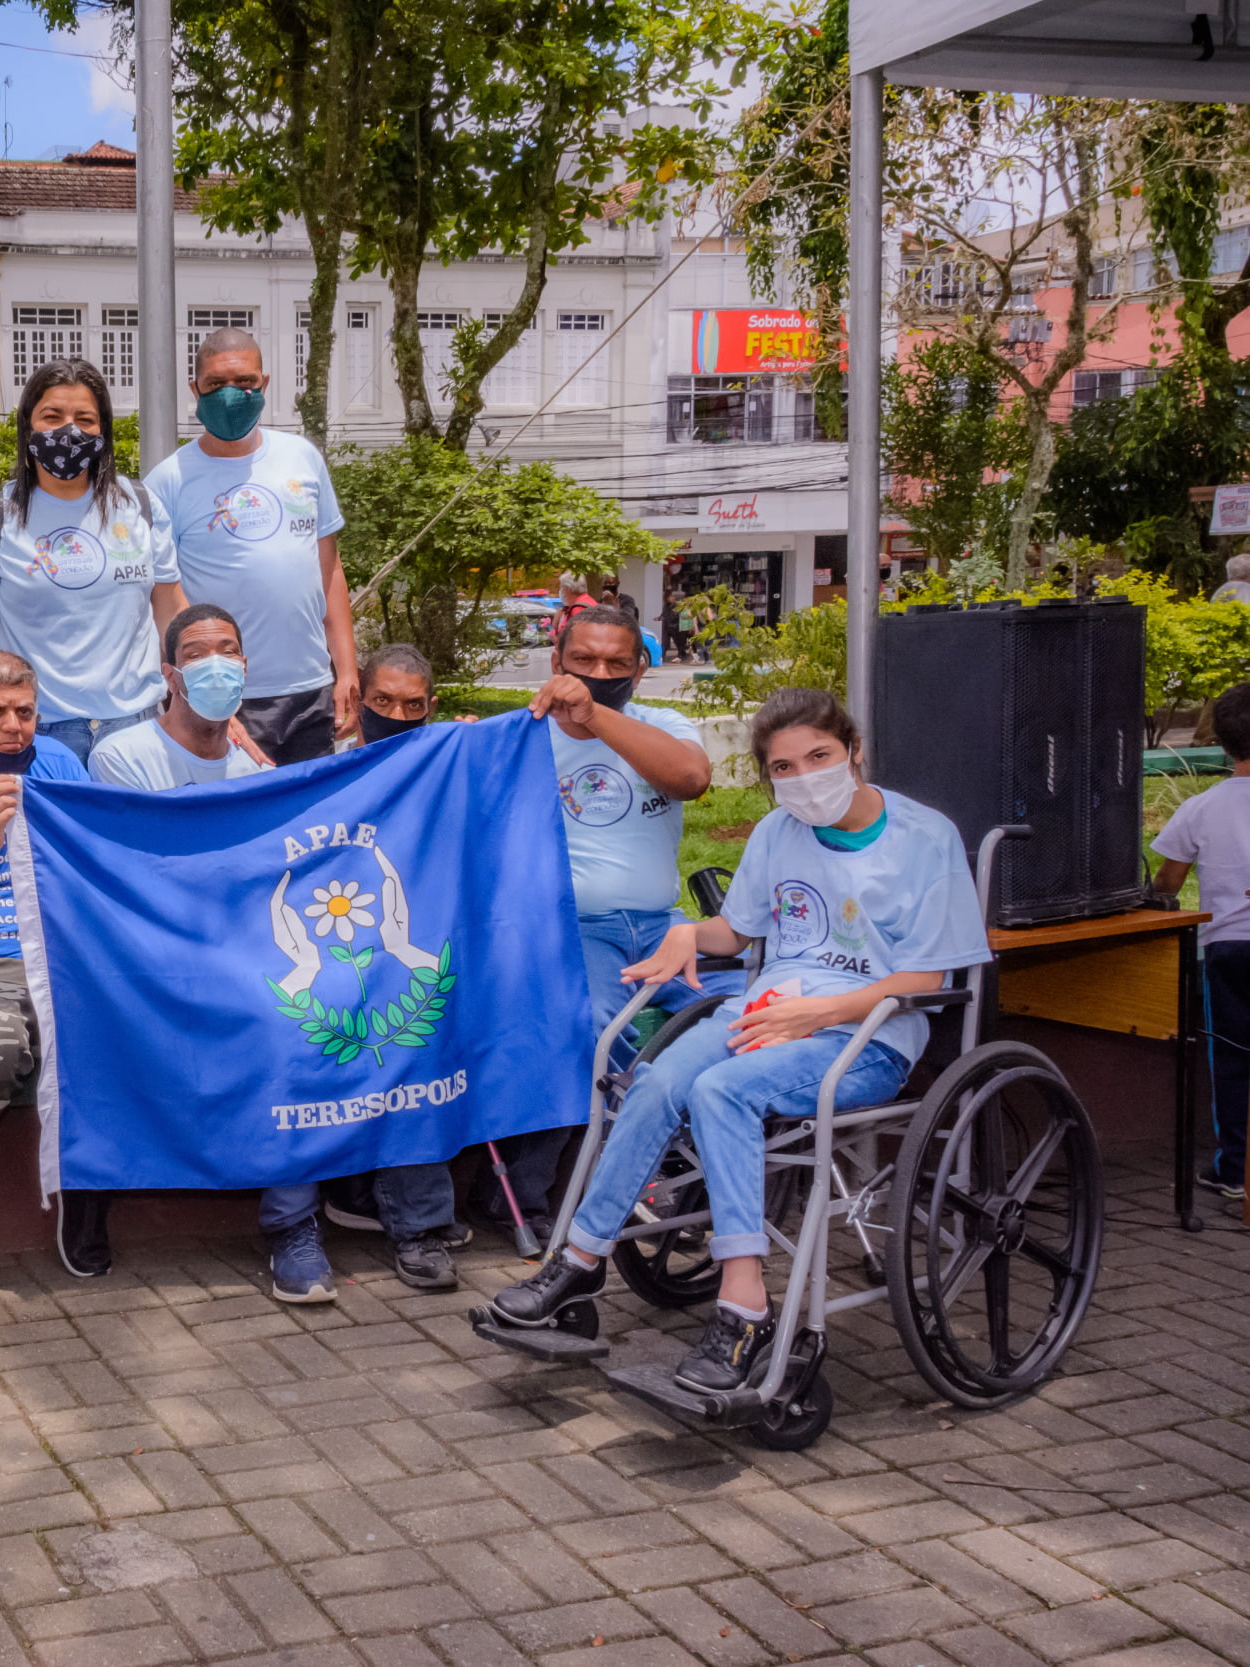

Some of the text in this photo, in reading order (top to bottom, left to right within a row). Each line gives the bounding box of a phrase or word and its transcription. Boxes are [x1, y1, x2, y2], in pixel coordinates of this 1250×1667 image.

[747, 314, 801, 328] Sobrado
[113, 564, 148, 581] APAE
[283, 822, 377, 864] APAE
[816, 951, 871, 975] APAE
[271, 1069, 468, 1131] TERESÓPOLIS
